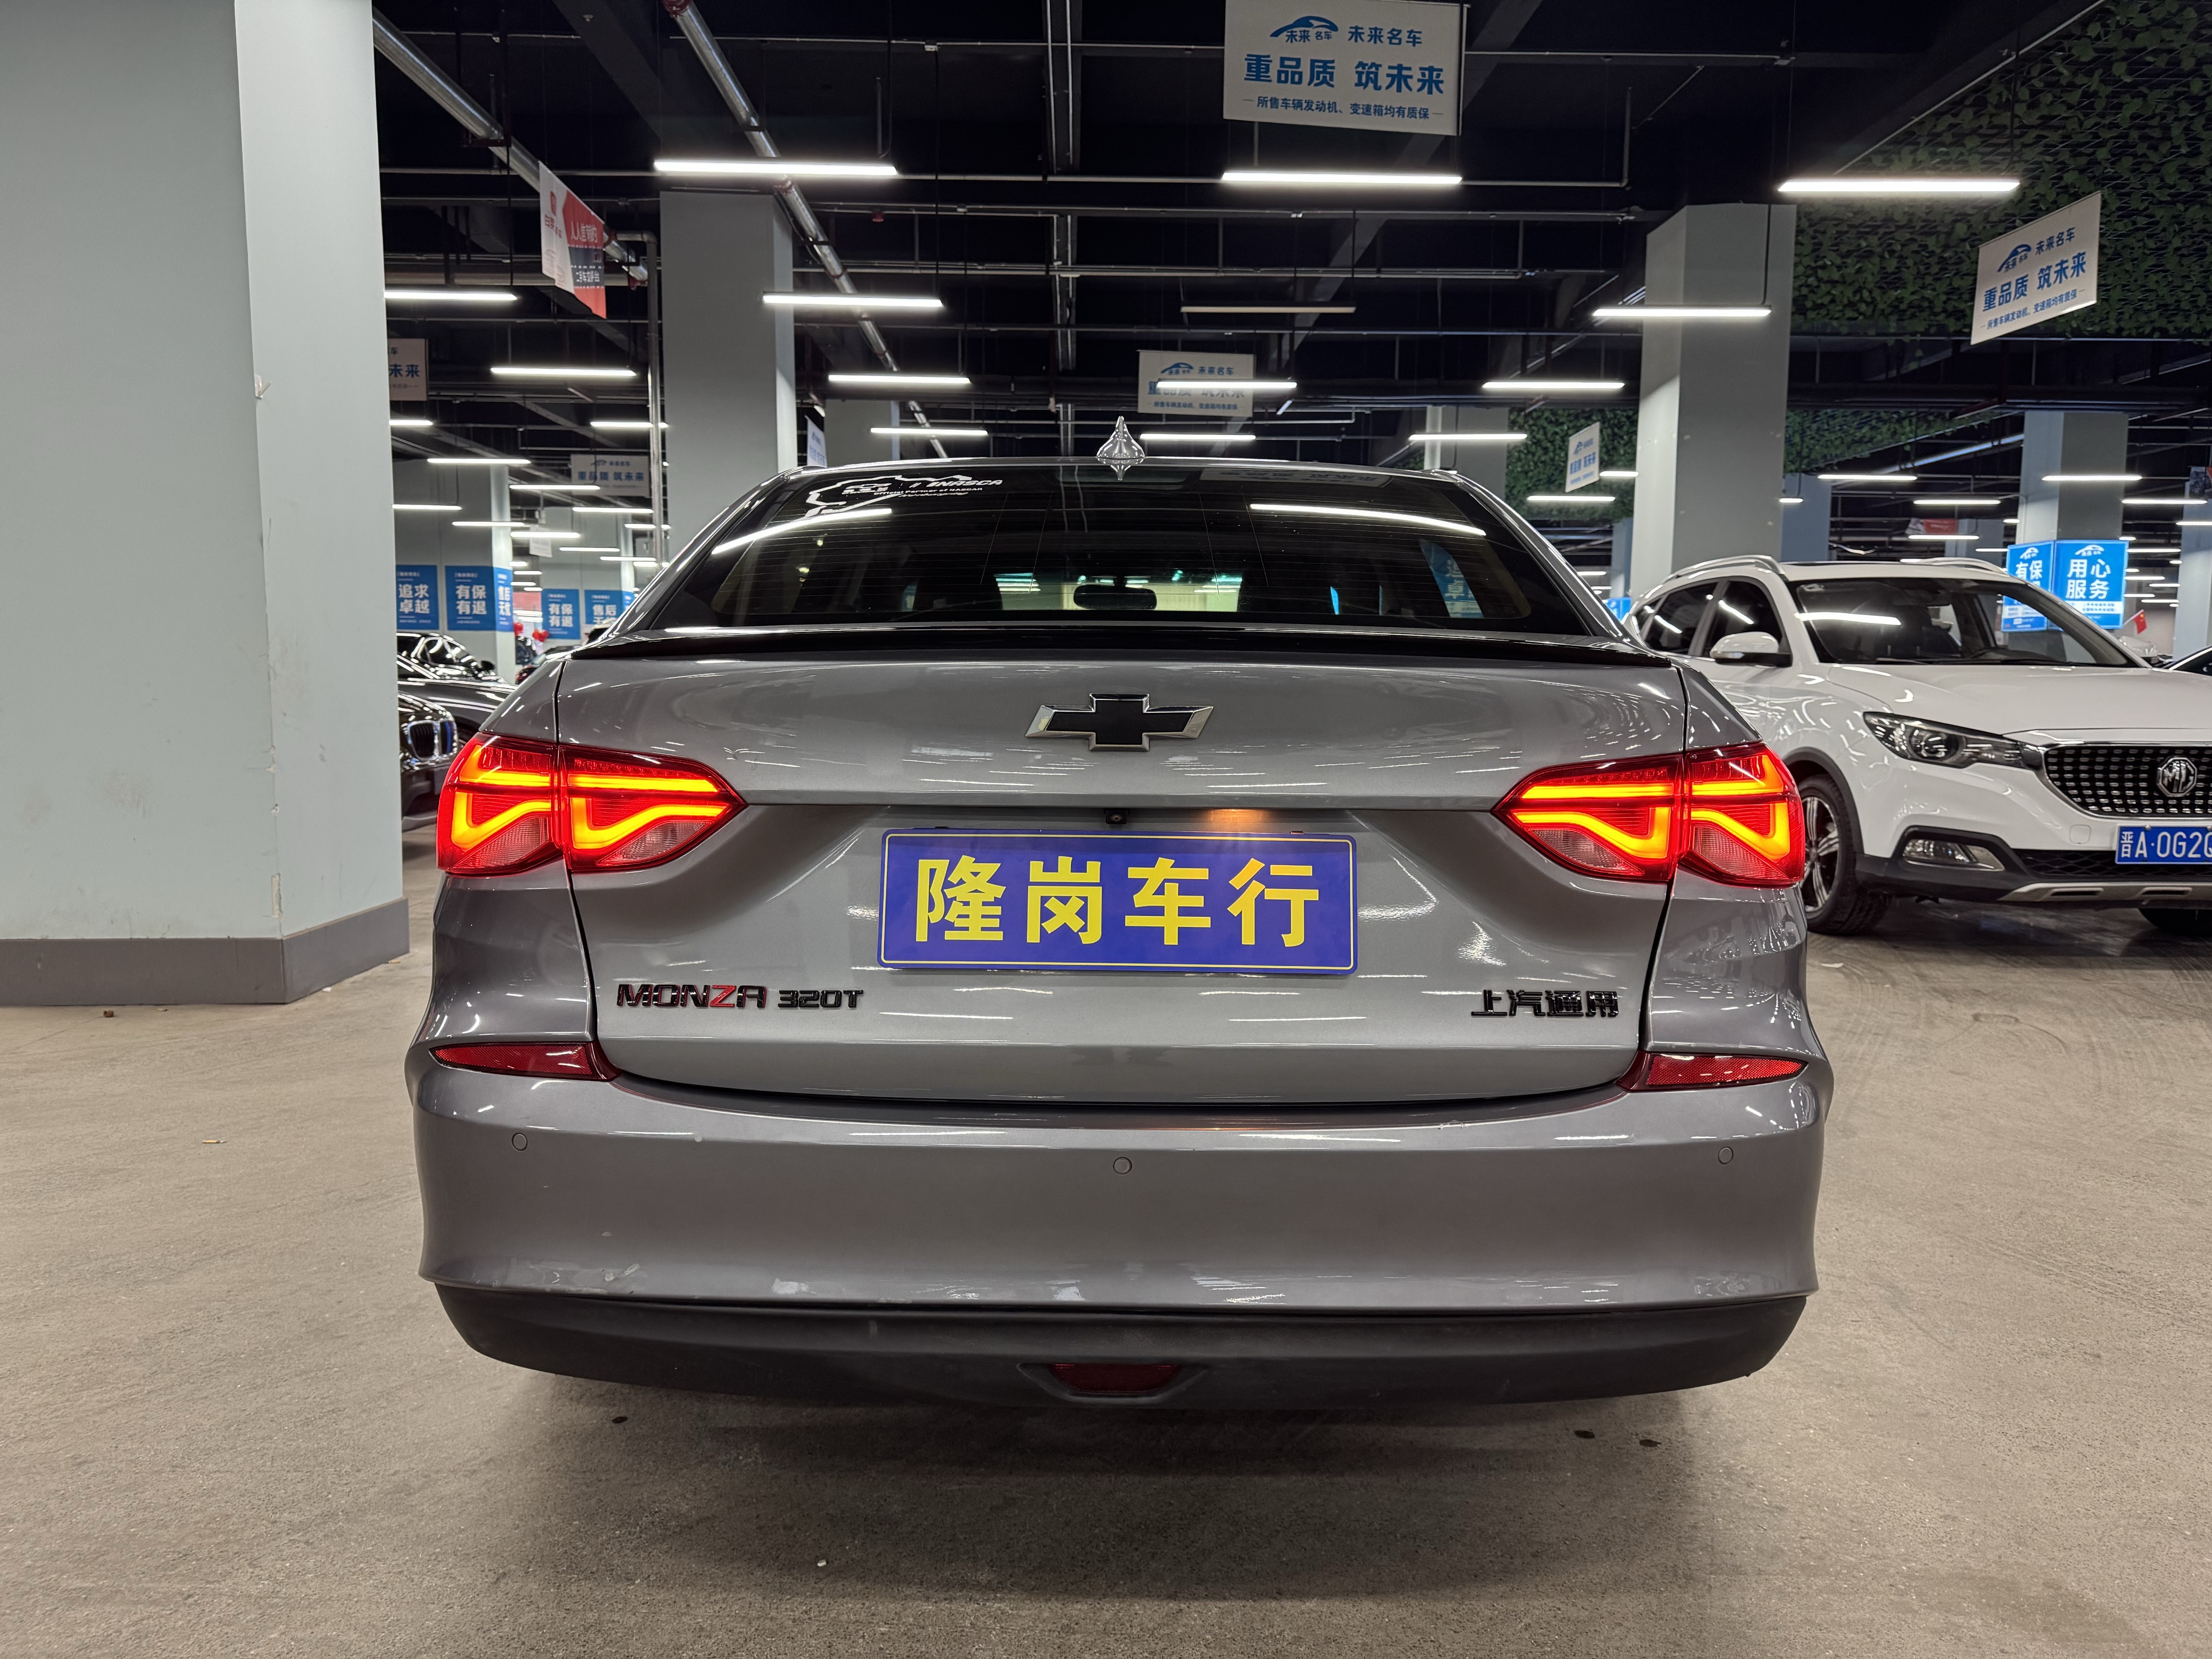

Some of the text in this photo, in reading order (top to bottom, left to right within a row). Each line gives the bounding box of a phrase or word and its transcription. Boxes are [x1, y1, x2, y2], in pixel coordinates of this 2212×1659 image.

[1348, 25, 1422, 47] 未来名车
[1244, 53, 1444, 95] 重品质 筑未来
[2035, 227, 2075, 256] 未来名车
[1983, 251, 2086, 312] 重品质 筑未来
[2067, 558, 2111, 578] 用心
[398, 584, 430, 598] 追求
[455, 585, 487, 599] 有保
[2065, 579, 2109, 599] 服务
[399, 599, 430, 614] 卓越
[456, 601, 487, 615] 有退
[915, 854, 1319, 948] 隆岗车行
[617, 984, 864, 1009] MONZA 320T
[1471, 989, 1620, 1018] 上汽通用
